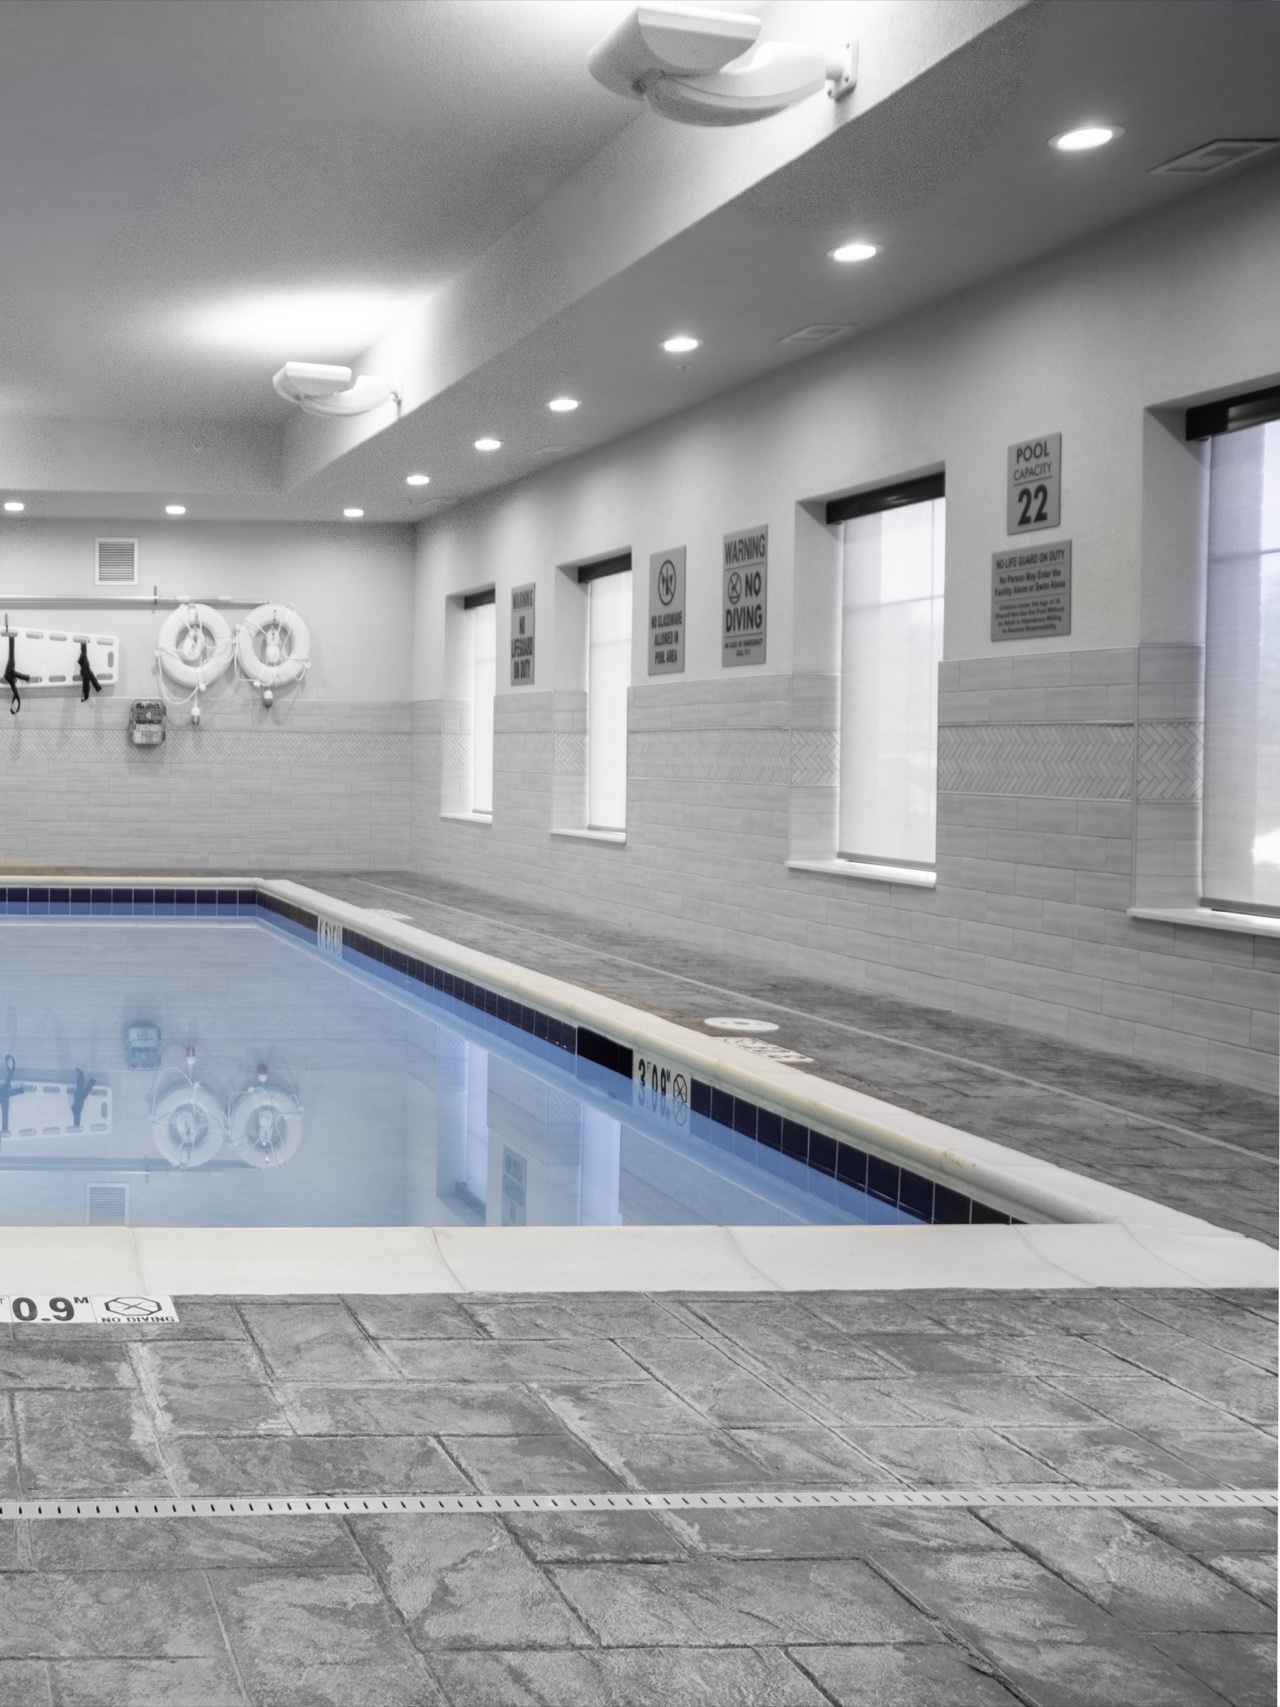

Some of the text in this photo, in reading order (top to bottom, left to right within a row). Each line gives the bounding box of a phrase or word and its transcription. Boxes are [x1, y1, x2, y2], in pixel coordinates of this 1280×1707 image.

[1016, 440, 1050, 464] POOL
[1013, 461, 1052, 481] CAPACITY
[1018, 483, 1048, 526] 22
[724, 533, 766, 565] WARNING
[995, 549, 1065, 569] NO LIFE GUARD ON DUTY
[744, 571, 762, 597] NO
[1007, 574, 1025, 583] Person
[1026, 572, 1036, 582] May
[1037, 569, 1051, 579] Enter
[995, 586, 1012, 597] Facility
[1013, 585, 1028, 594] Alone
[1035, 582, 1050, 591] Swim
[1050, 580, 1066, 589] Alone
[658, 611, 683, 628] GLASSWARE
[726, 603, 763, 632] DIVING
